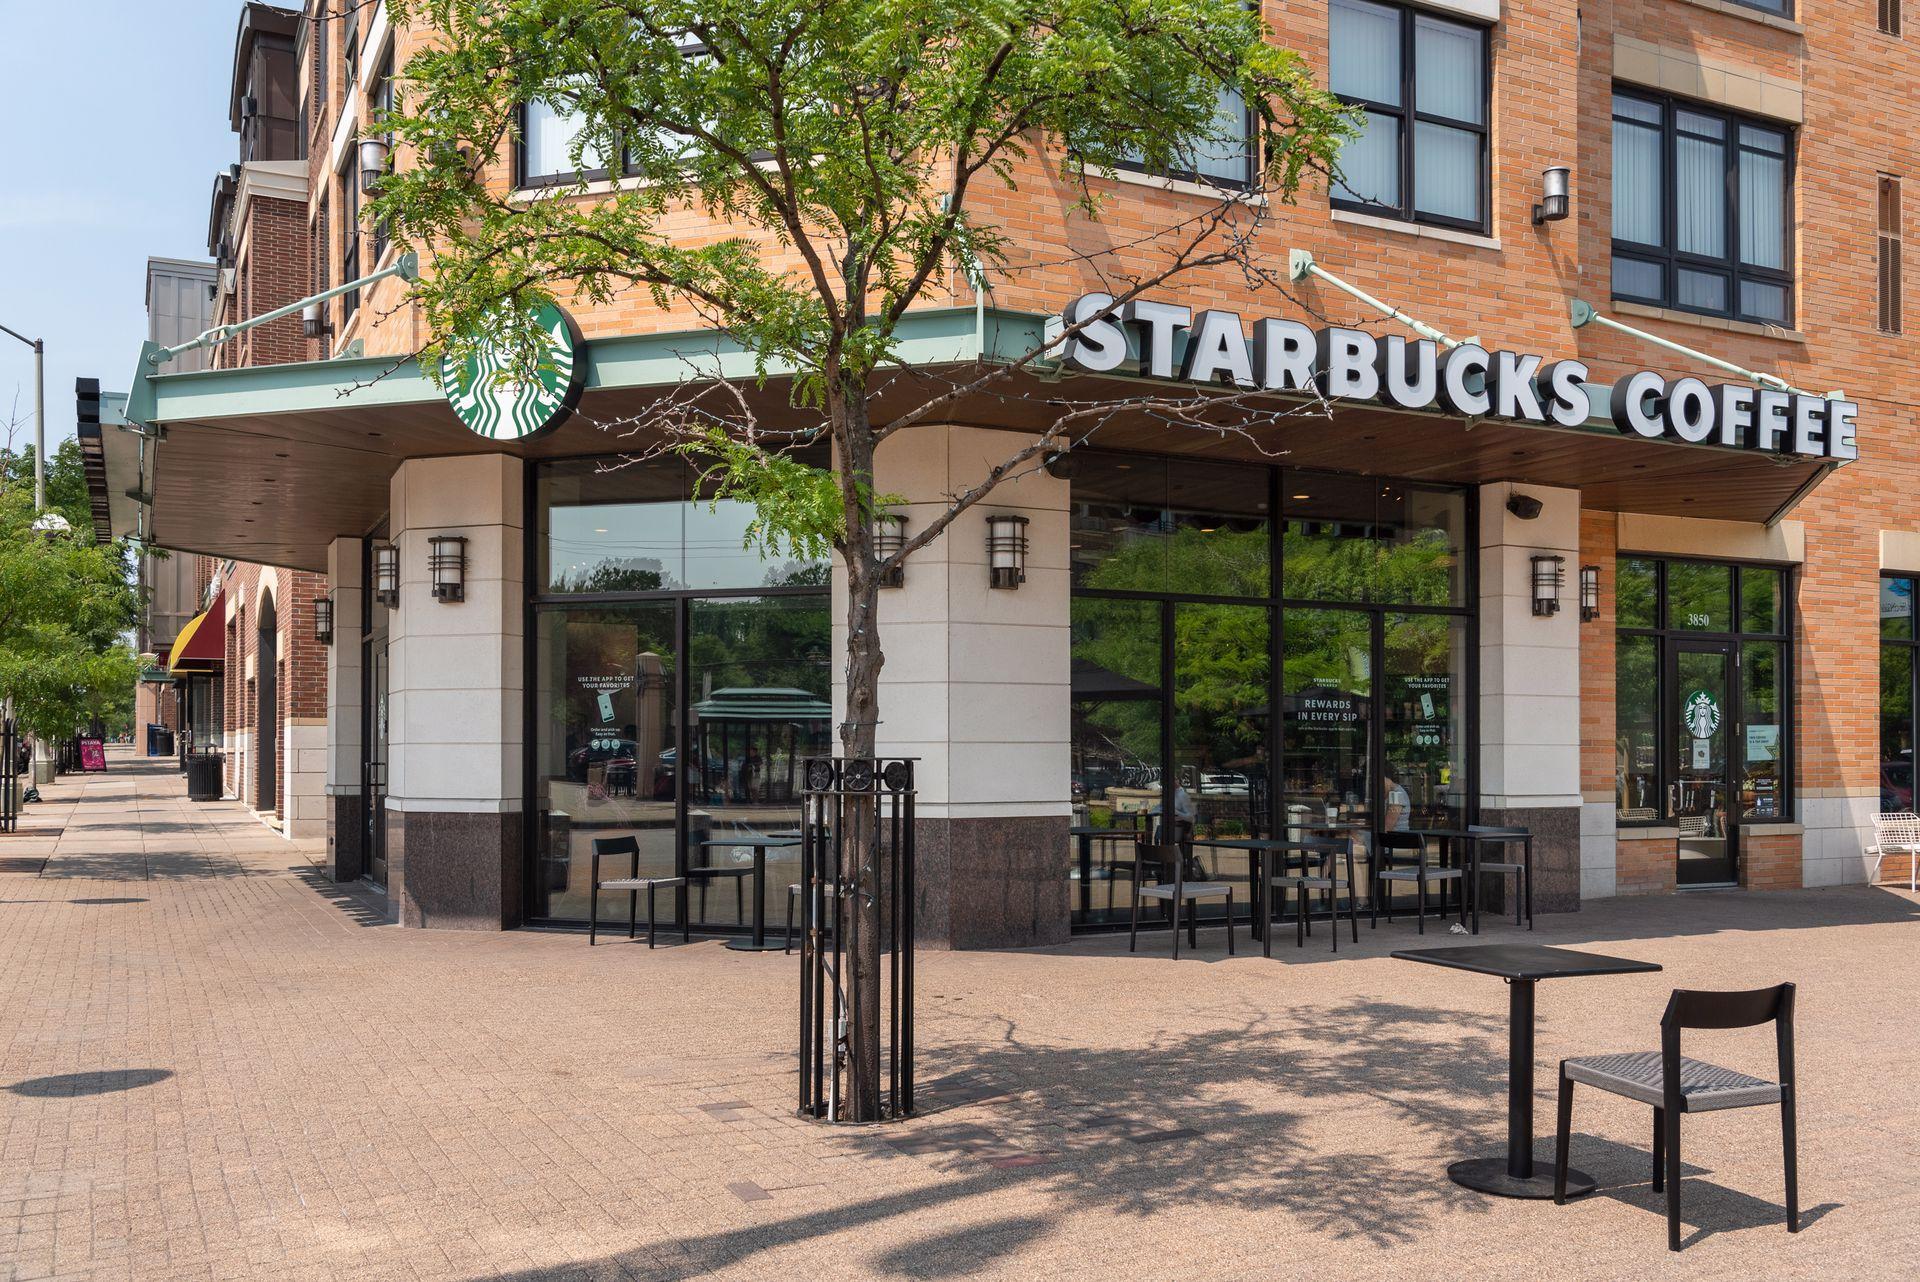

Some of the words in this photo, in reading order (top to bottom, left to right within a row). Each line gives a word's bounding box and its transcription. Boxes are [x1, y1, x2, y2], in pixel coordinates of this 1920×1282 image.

[1064, 292, 1589, 427] STARBUCKS
[1610, 371, 1859, 460] COFFEE
[1687, 613, 1709, 627] 3850
[1304, 699, 1351, 709] REWARDS
[1297, 711, 1308, 721] IN
[1311, 712, 1340, 721] EVERY
[1342, 712, 1358, 722] SIP
